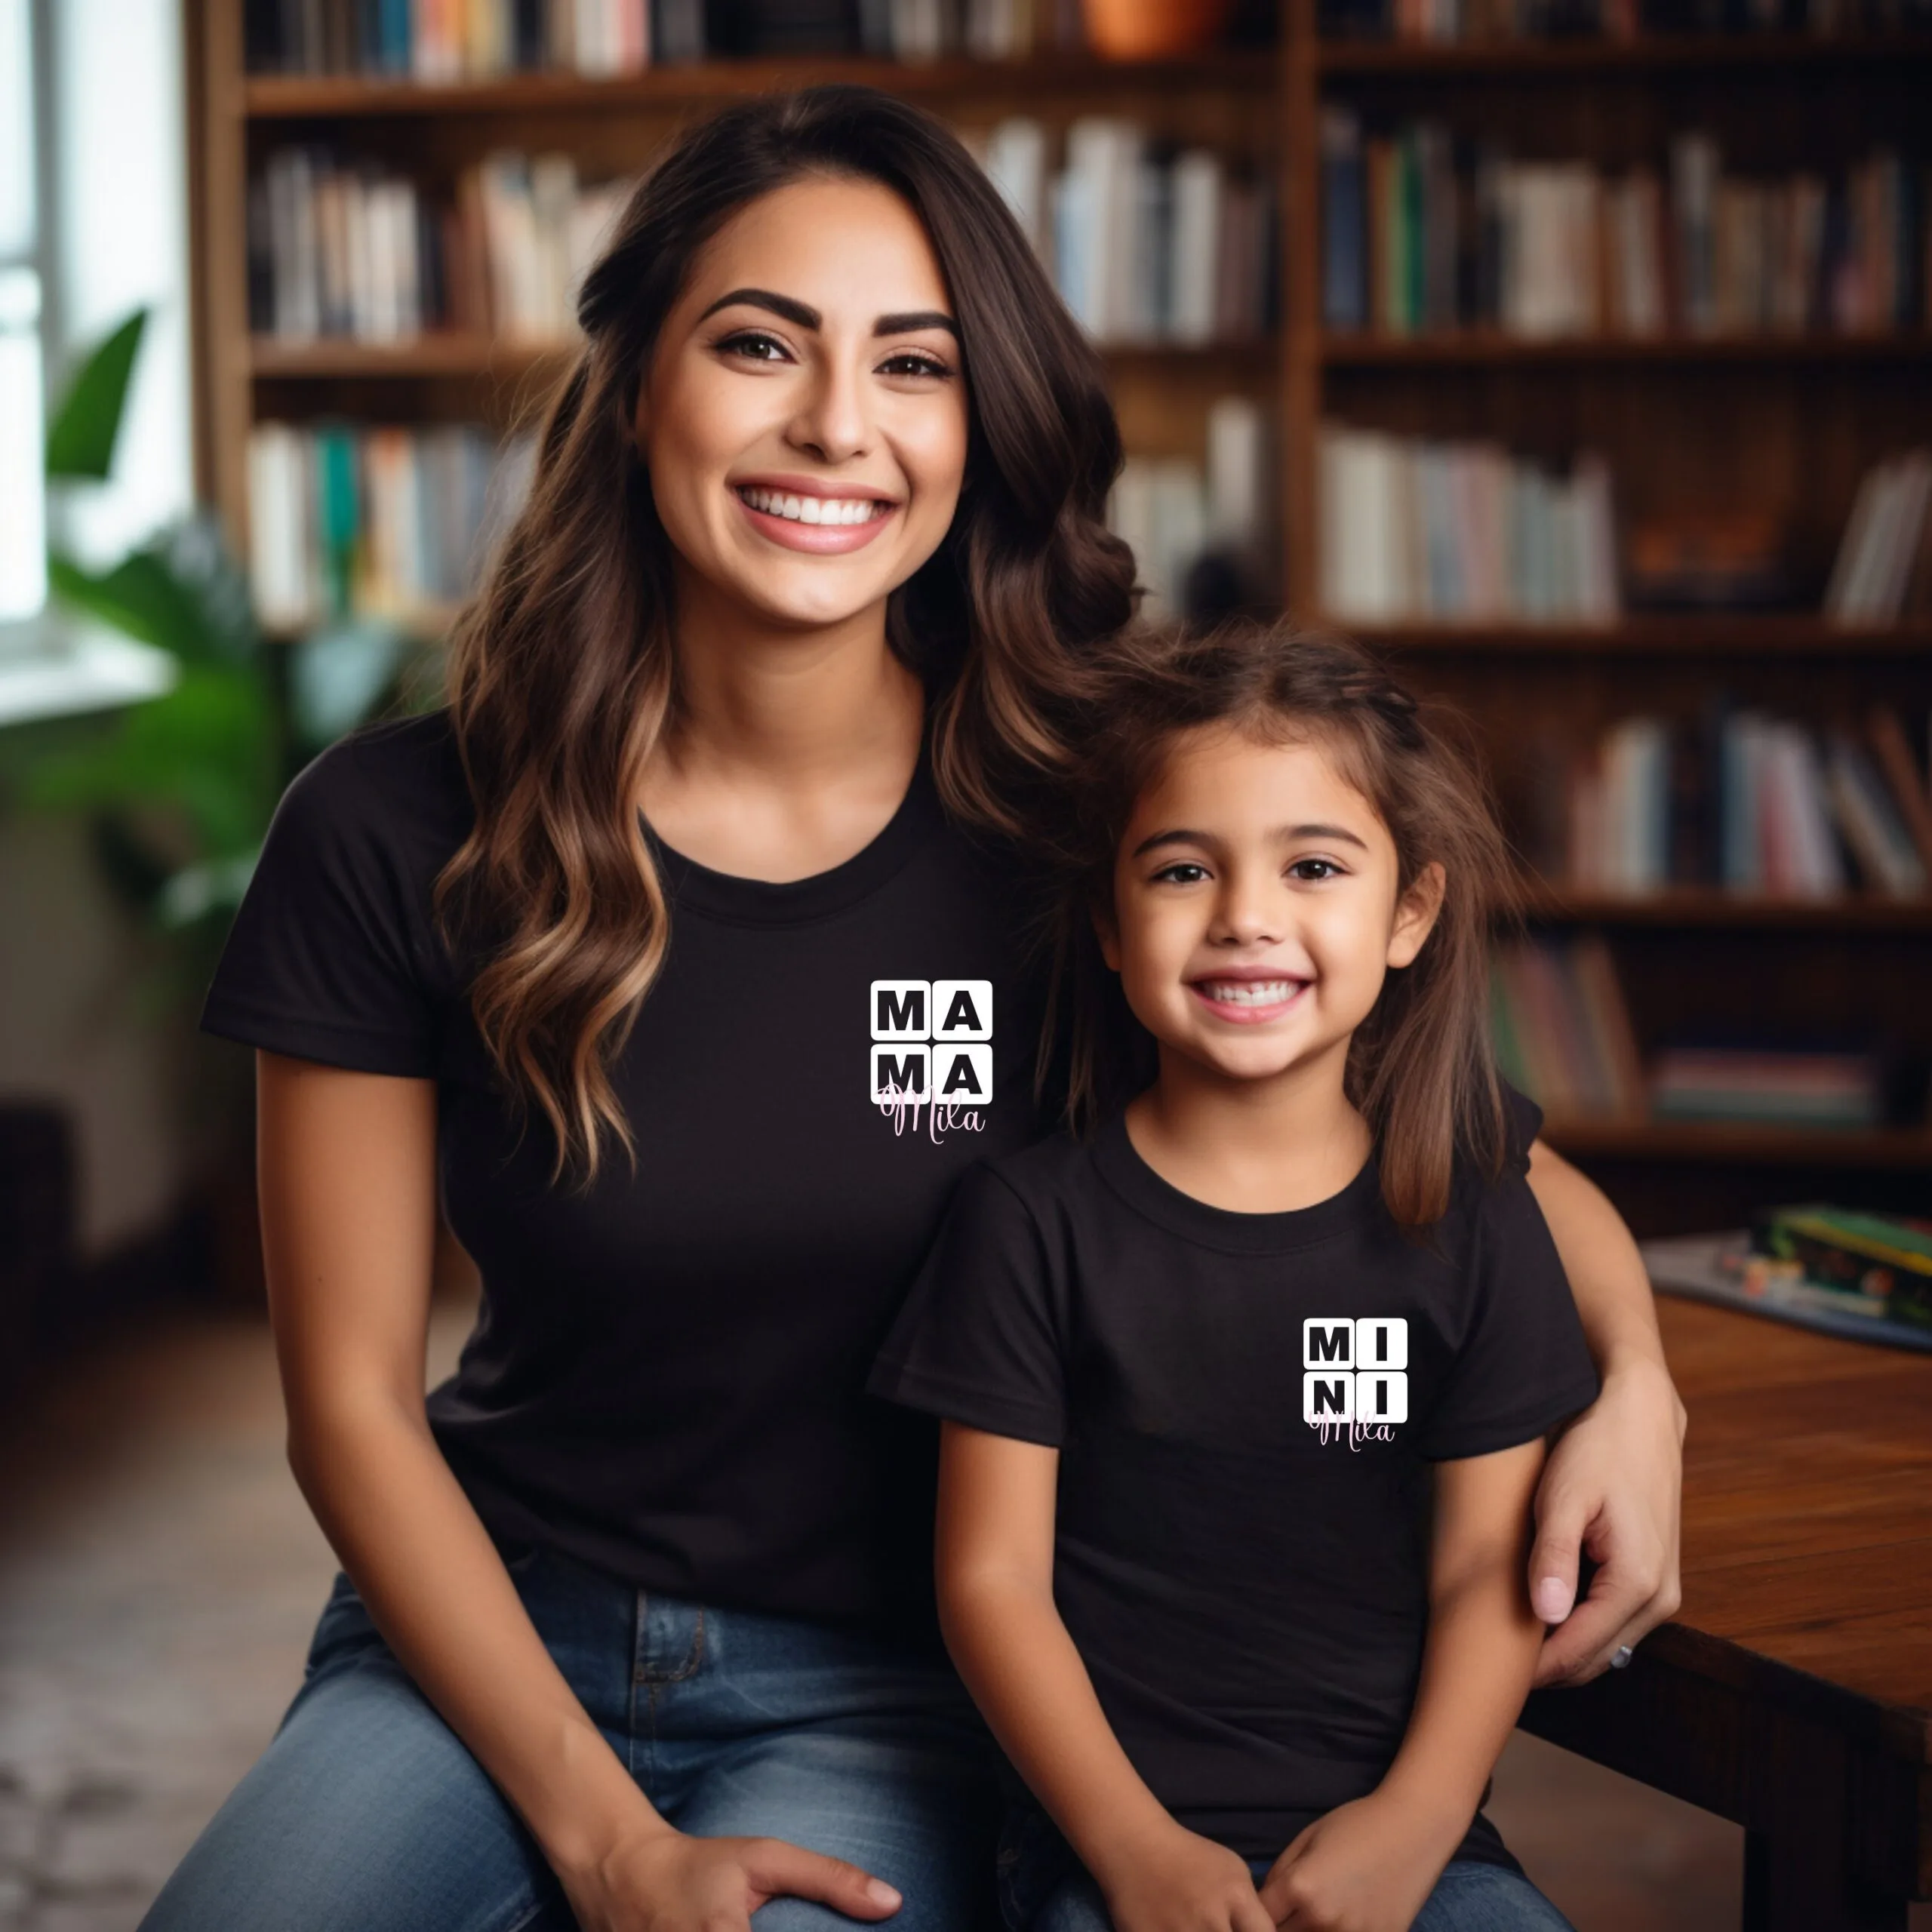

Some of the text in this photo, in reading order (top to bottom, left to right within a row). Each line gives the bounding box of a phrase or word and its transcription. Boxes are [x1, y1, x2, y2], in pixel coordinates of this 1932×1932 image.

[878, 990, 983, 1030] MA
[878, 1054, 983, 1094] MA
[873, 1083, 986, 1144] Mila
[1309, 1327, 1387, 1361] MI
[1314, 1380, 1387, 1414] NI
[1309, 1410, 1395, 1452] Mila
